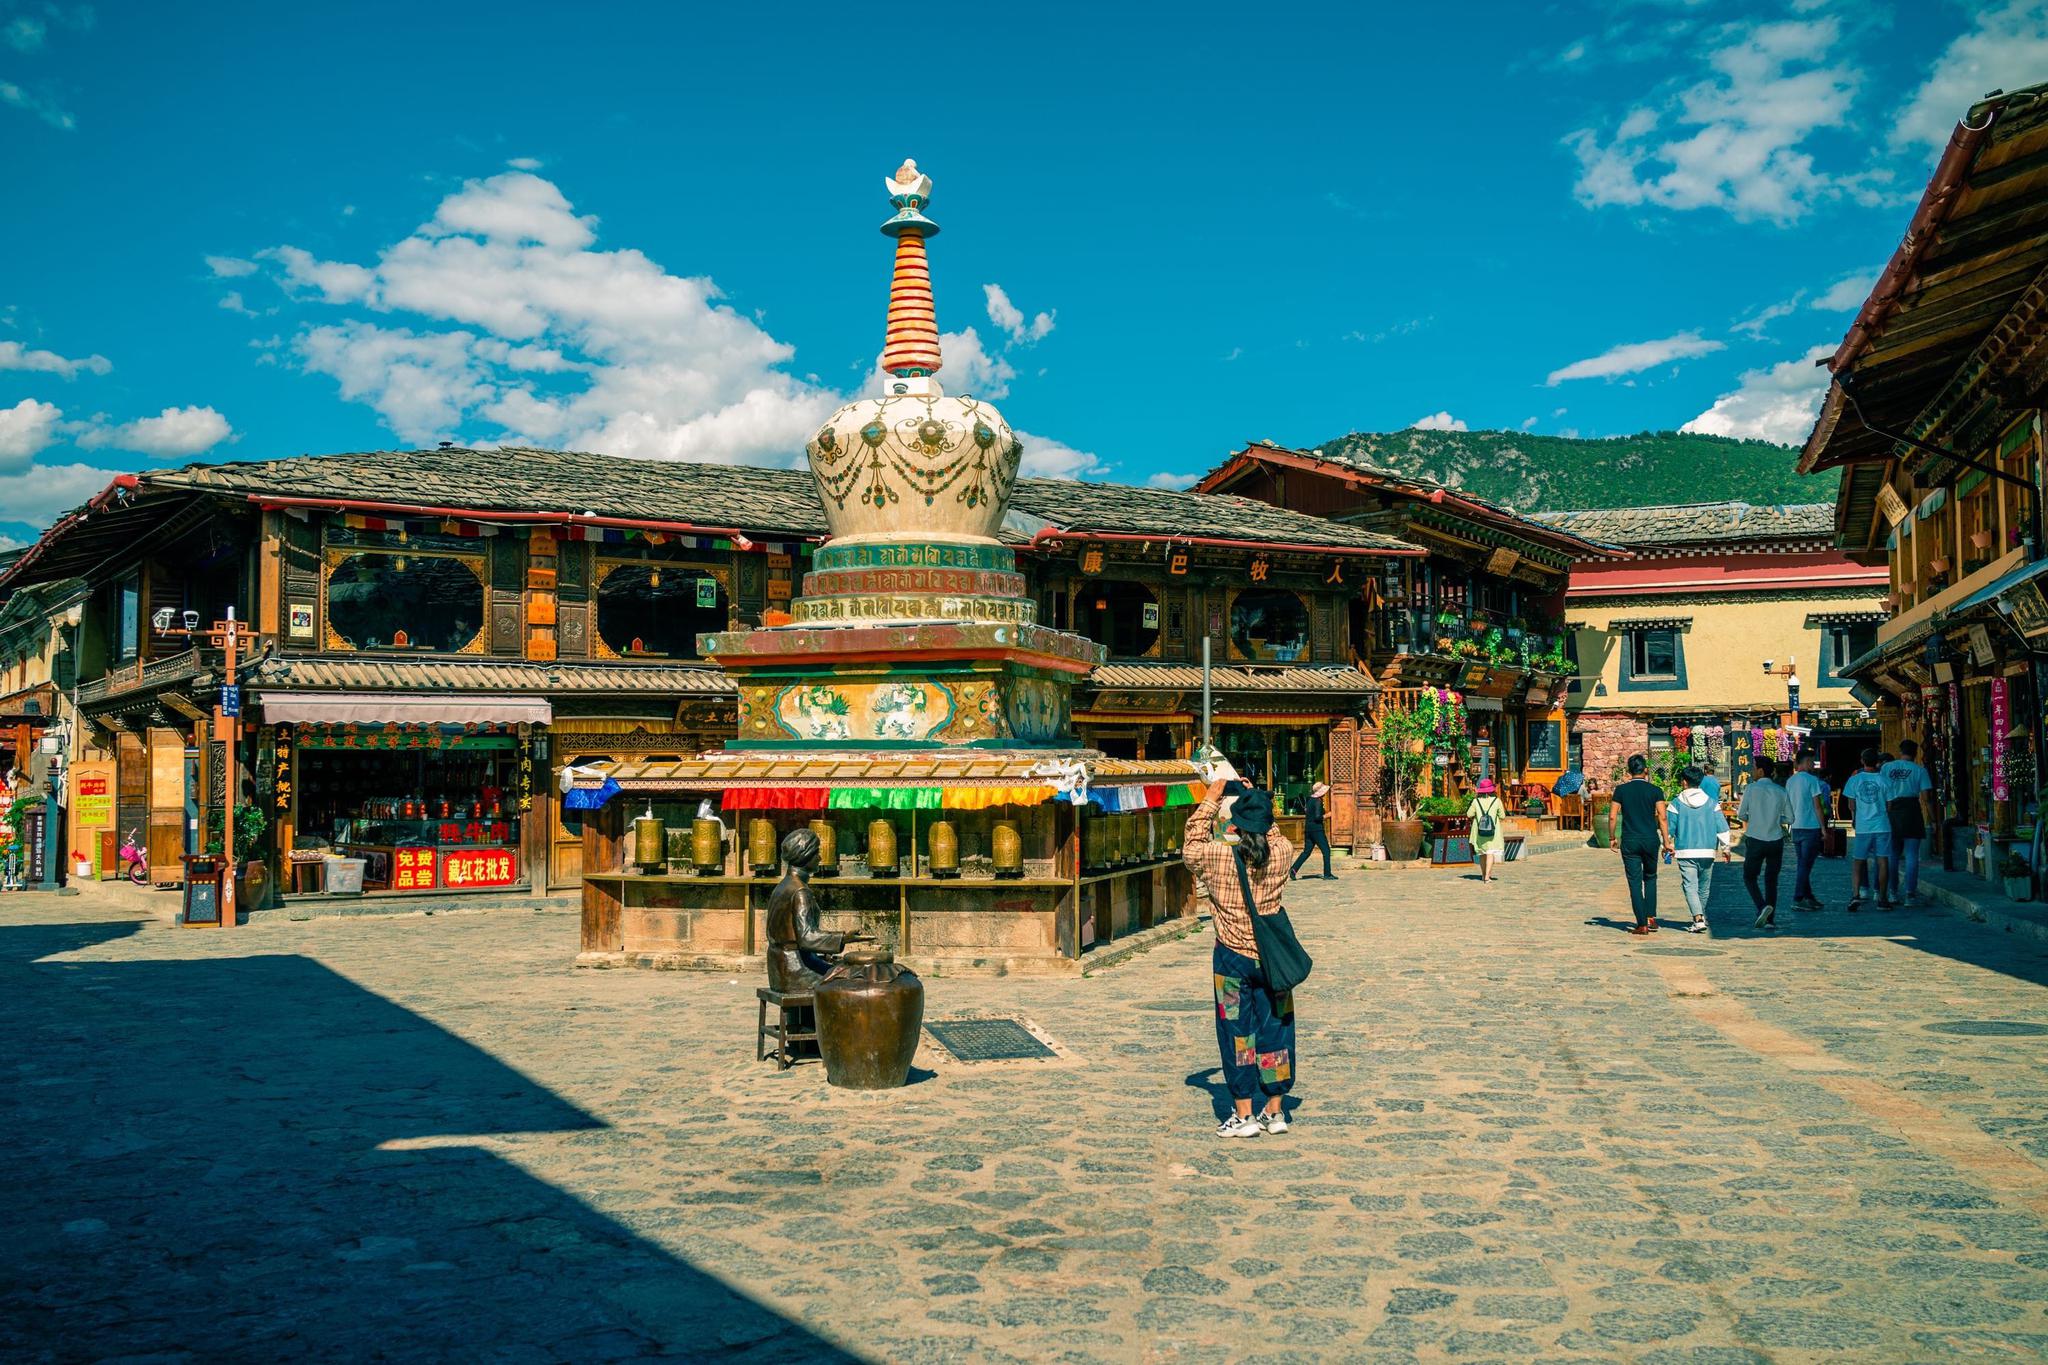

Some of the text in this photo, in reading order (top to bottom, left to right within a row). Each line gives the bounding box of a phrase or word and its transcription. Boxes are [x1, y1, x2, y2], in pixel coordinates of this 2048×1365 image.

[297, 734, 464, 750] 冬虫夏草等土特产
[276, 728, 292, 809] 土特产批发
[520, 738, 532, 809] 牛肉专卖
[398, 849, 433, 867] 免费
[398, 869, 433, 887] 品尝
[447, 857, 510, 883] 藏红花批发
